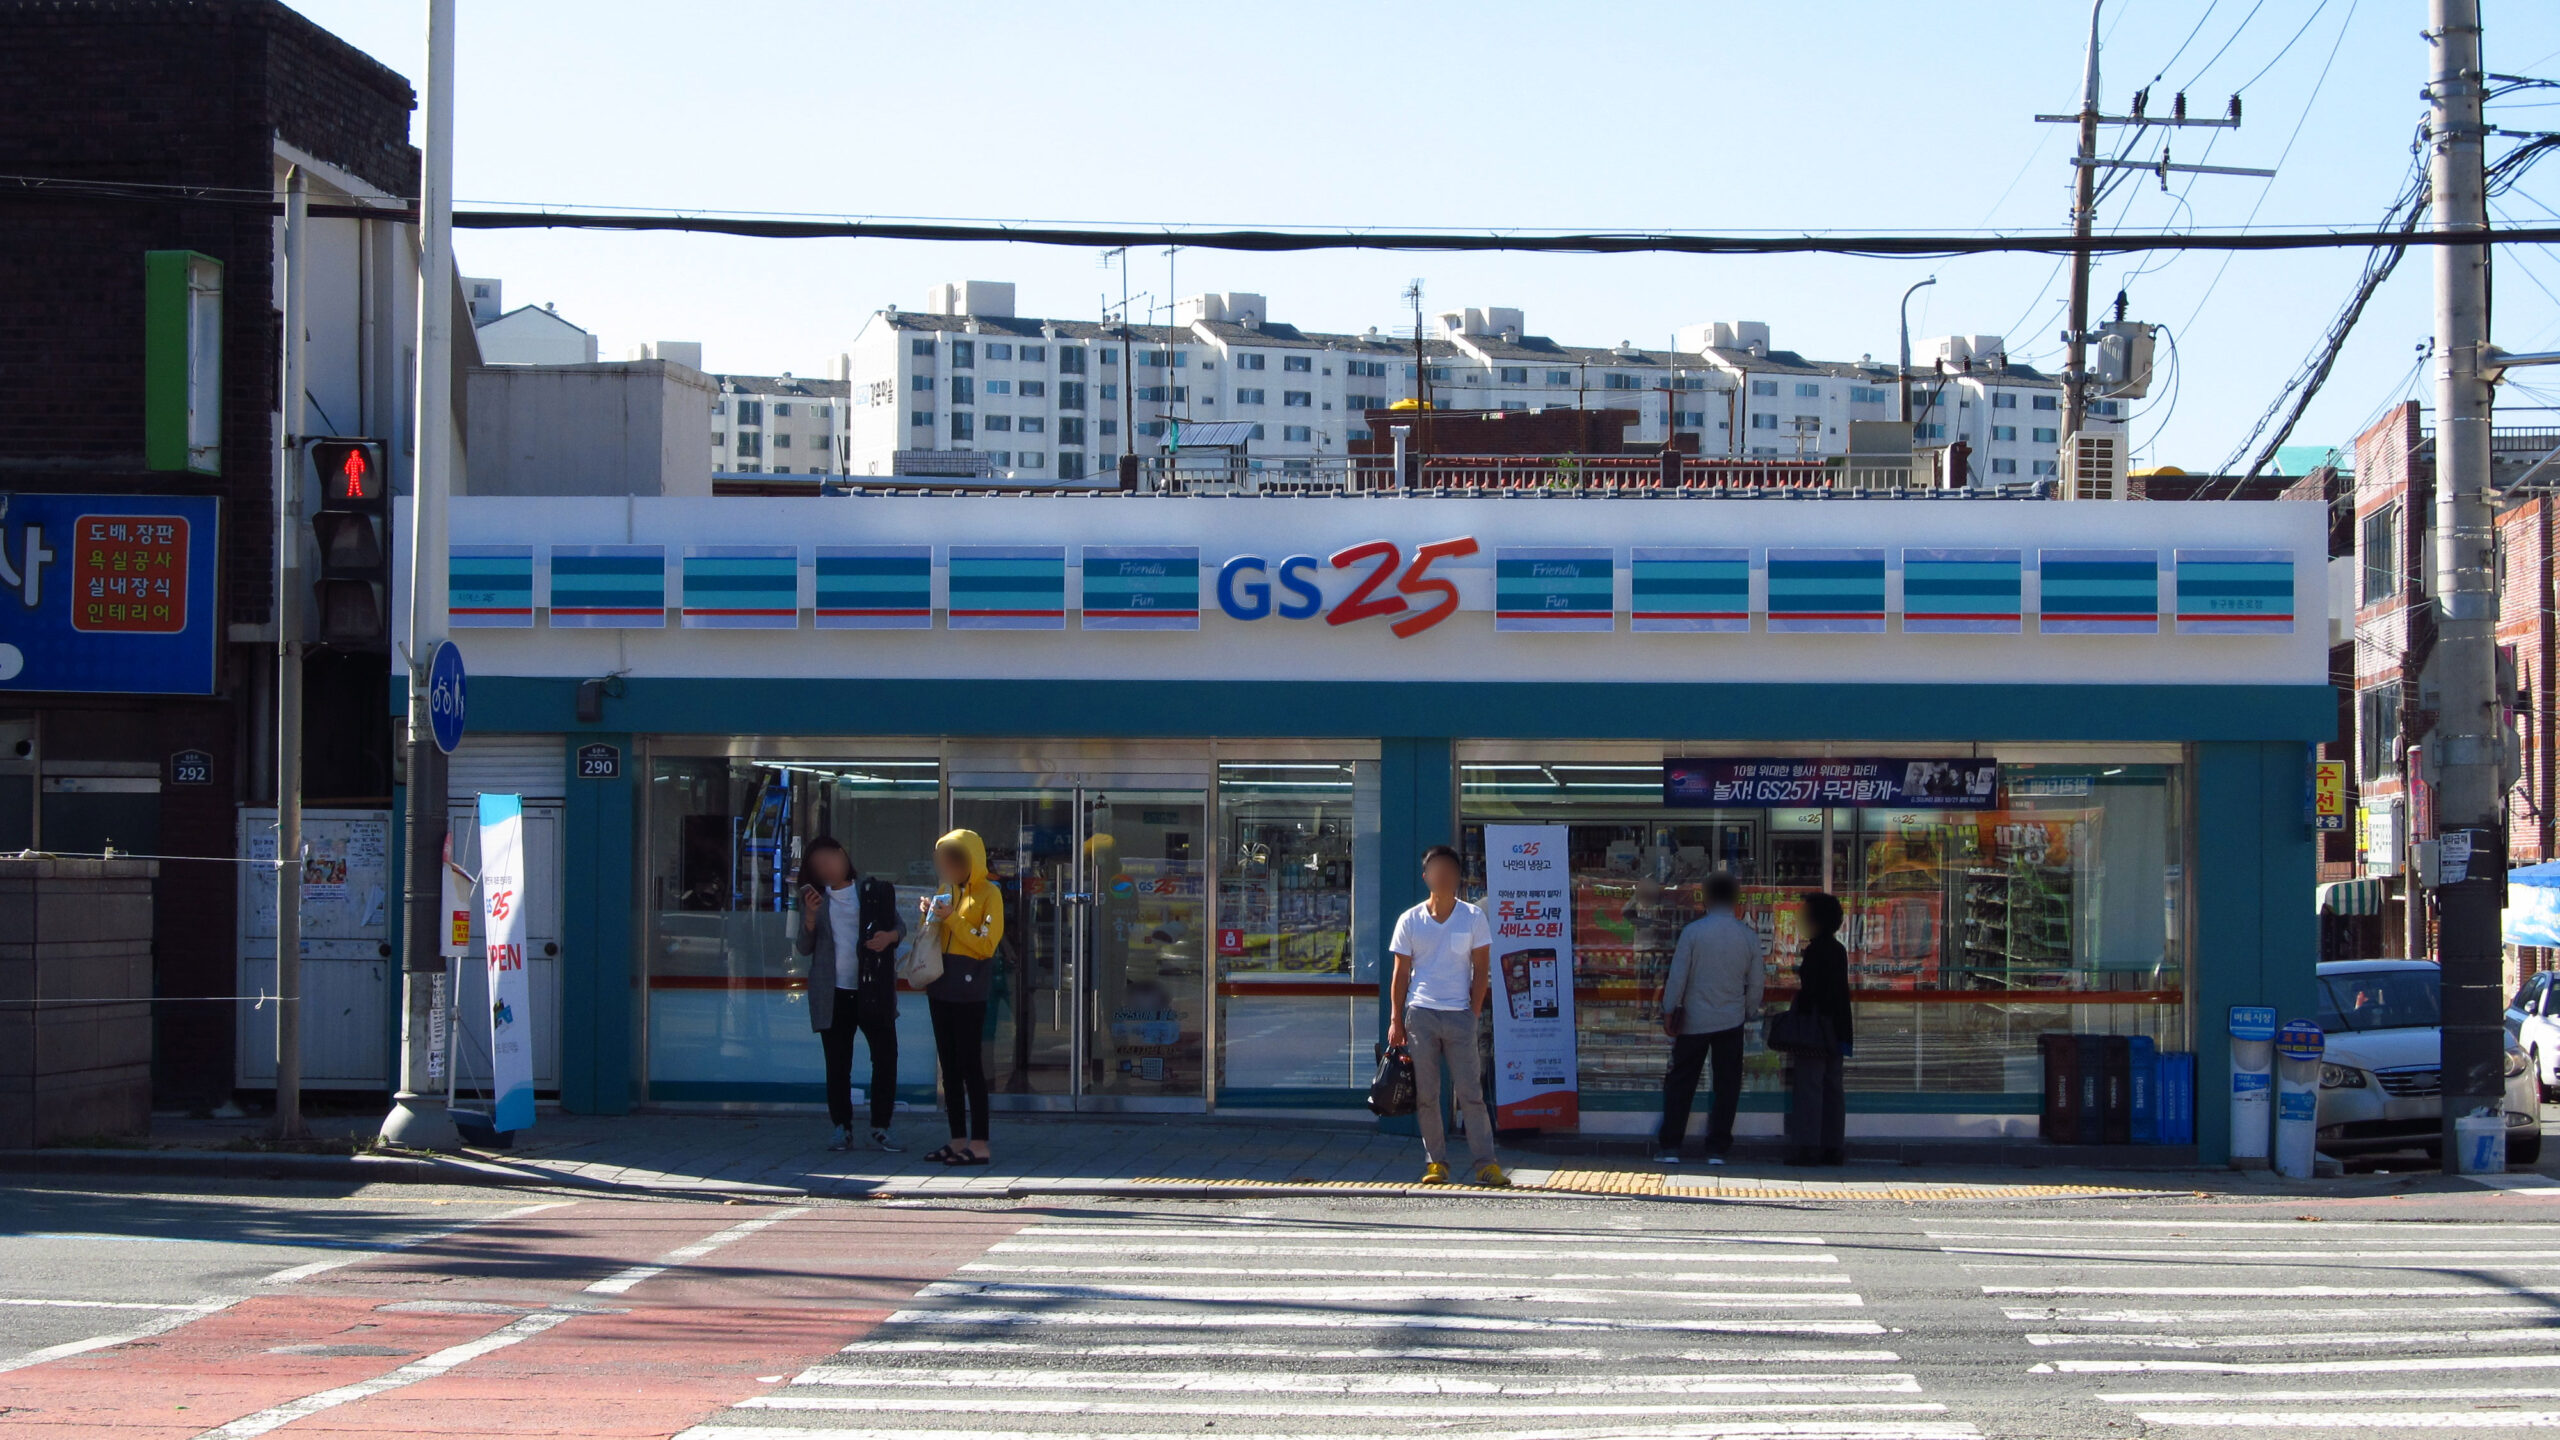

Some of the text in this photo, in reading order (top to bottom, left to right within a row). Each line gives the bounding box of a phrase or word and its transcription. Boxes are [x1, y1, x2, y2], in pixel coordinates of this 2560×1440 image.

[88, 523, 175, 545] 도배,장판
[88, 550, 173, 572] 욕실공사
[1119, 561, 1167, 577] Friendly
[1532, 562, 1581, 578] Friendly
[87, 576, 171, 598] 실내장식
[1215, 536, 1480, 640] GS25
[1130, 593, 1155, 607] Fun
[1545, 594, 1569, 608] Fun
[87, 602, 170, 624] 인테리어
[178, 767, 206, 781] 292
[585, 760, 613, 774] 290
[1732, 764, 1878, 778] 10월 위대한 행사! 위대한 파티!
[1713, 779, 1752, 801] 놀자!
[1756, 780, 1820, 801] GS25가
[1822, 779, 1902, 801] 무리할게~
[2316, 766, 2337, 813] 수선
[1798, 813, 1823, 824] GS25
[1053, 834, 1072, 845] AT
[1512, 841, 1541, 856] GS25
[1502, 859, 1552, 872] 나만의 냉장고
[1138, 878, 1180, 895] GS25
[1497, 900, 1561, 922] 주문도시락
[1497, 922, 1563, 938] 서비스 오픈!
[2233, 1012, 2272, 1024] 벼룩시장
